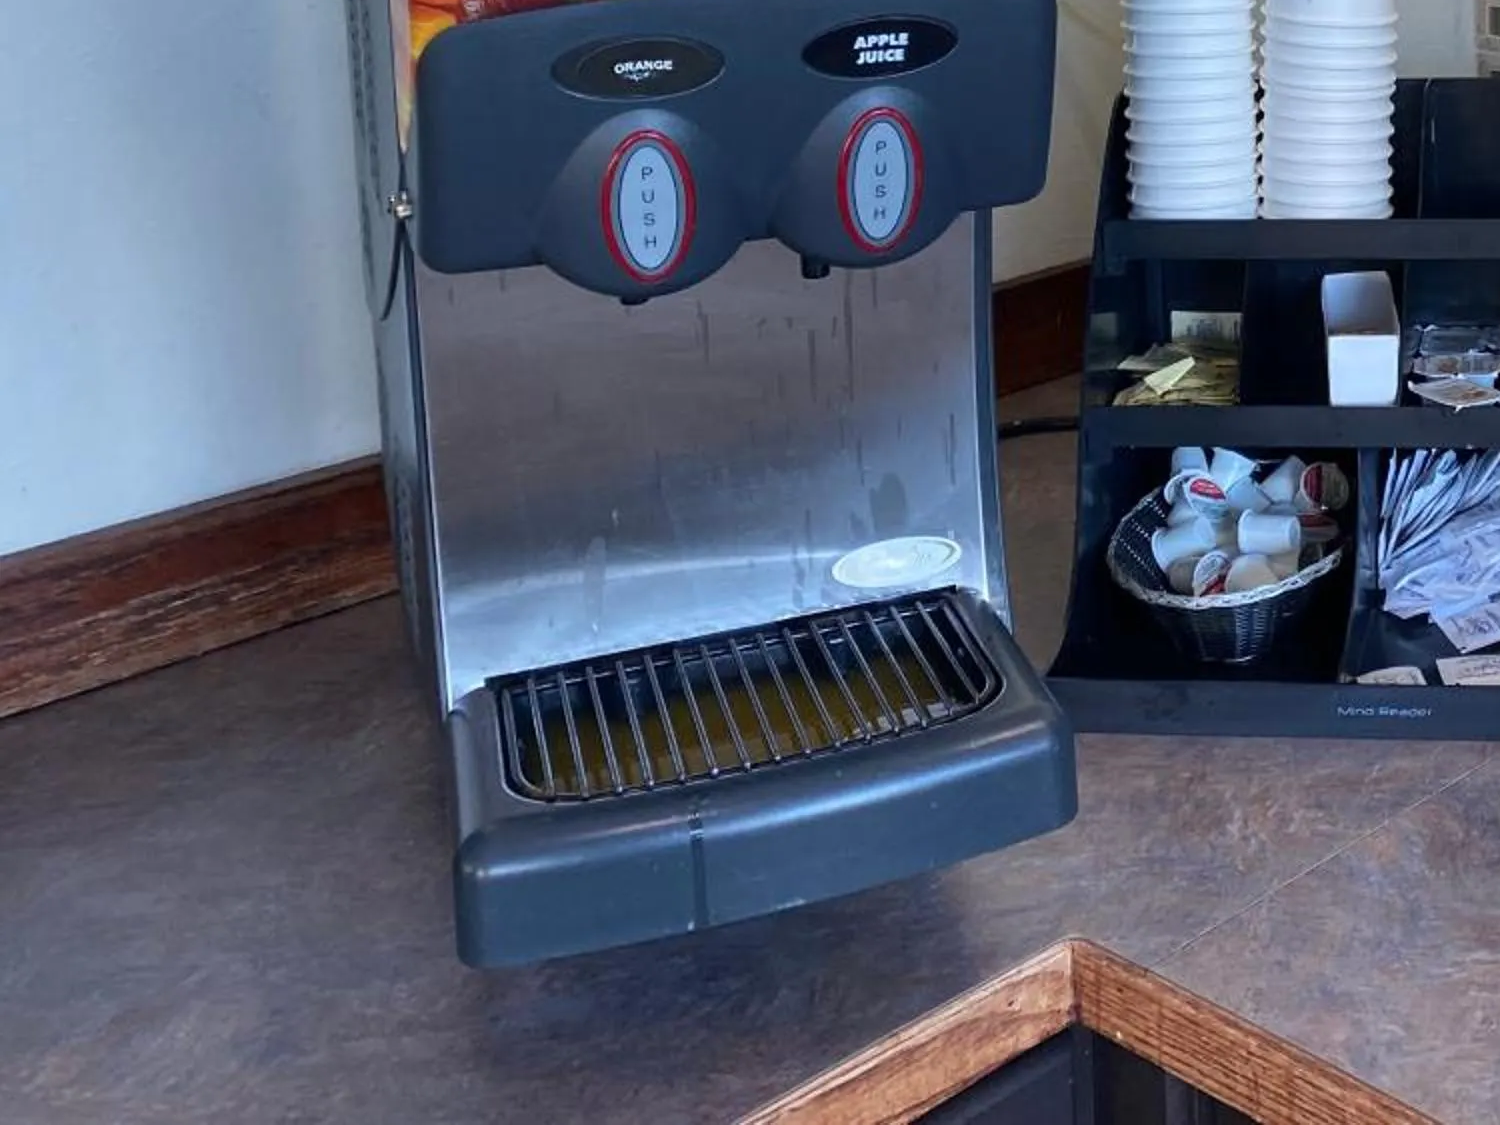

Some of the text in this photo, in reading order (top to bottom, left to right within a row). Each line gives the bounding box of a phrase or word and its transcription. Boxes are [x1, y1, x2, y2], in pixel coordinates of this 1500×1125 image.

[853, 32, 909, 49] APPLE
[855, 48, 905, 65] JUICE
[613, 59, 673, 75] ORANGE
